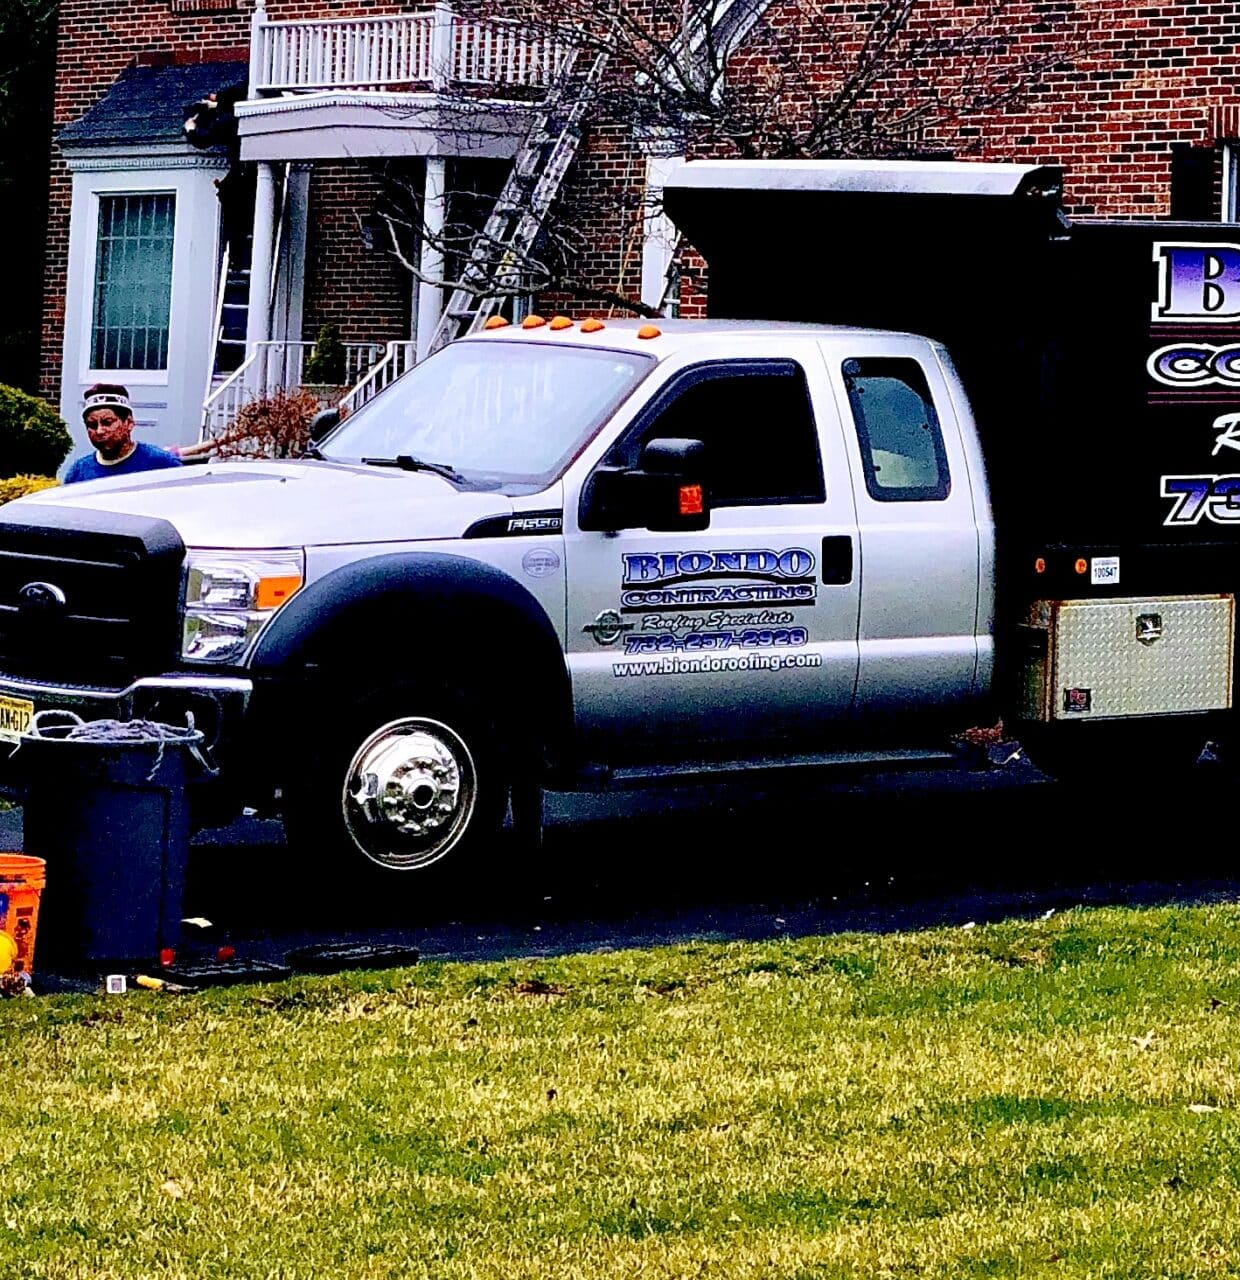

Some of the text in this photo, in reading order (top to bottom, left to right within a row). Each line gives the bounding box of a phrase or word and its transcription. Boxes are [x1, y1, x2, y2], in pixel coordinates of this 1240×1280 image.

[622, 548, 816, 583] BIONDO
[621, 584, 818, 606] CONTRACTING
[641, 613, 704, 633] Roofing
[706, 610, 794, 629] Specialists
[624, 627, 808, 655] 732-257-2926
[612, 653, 822, 677] www.biondoroofing.com
